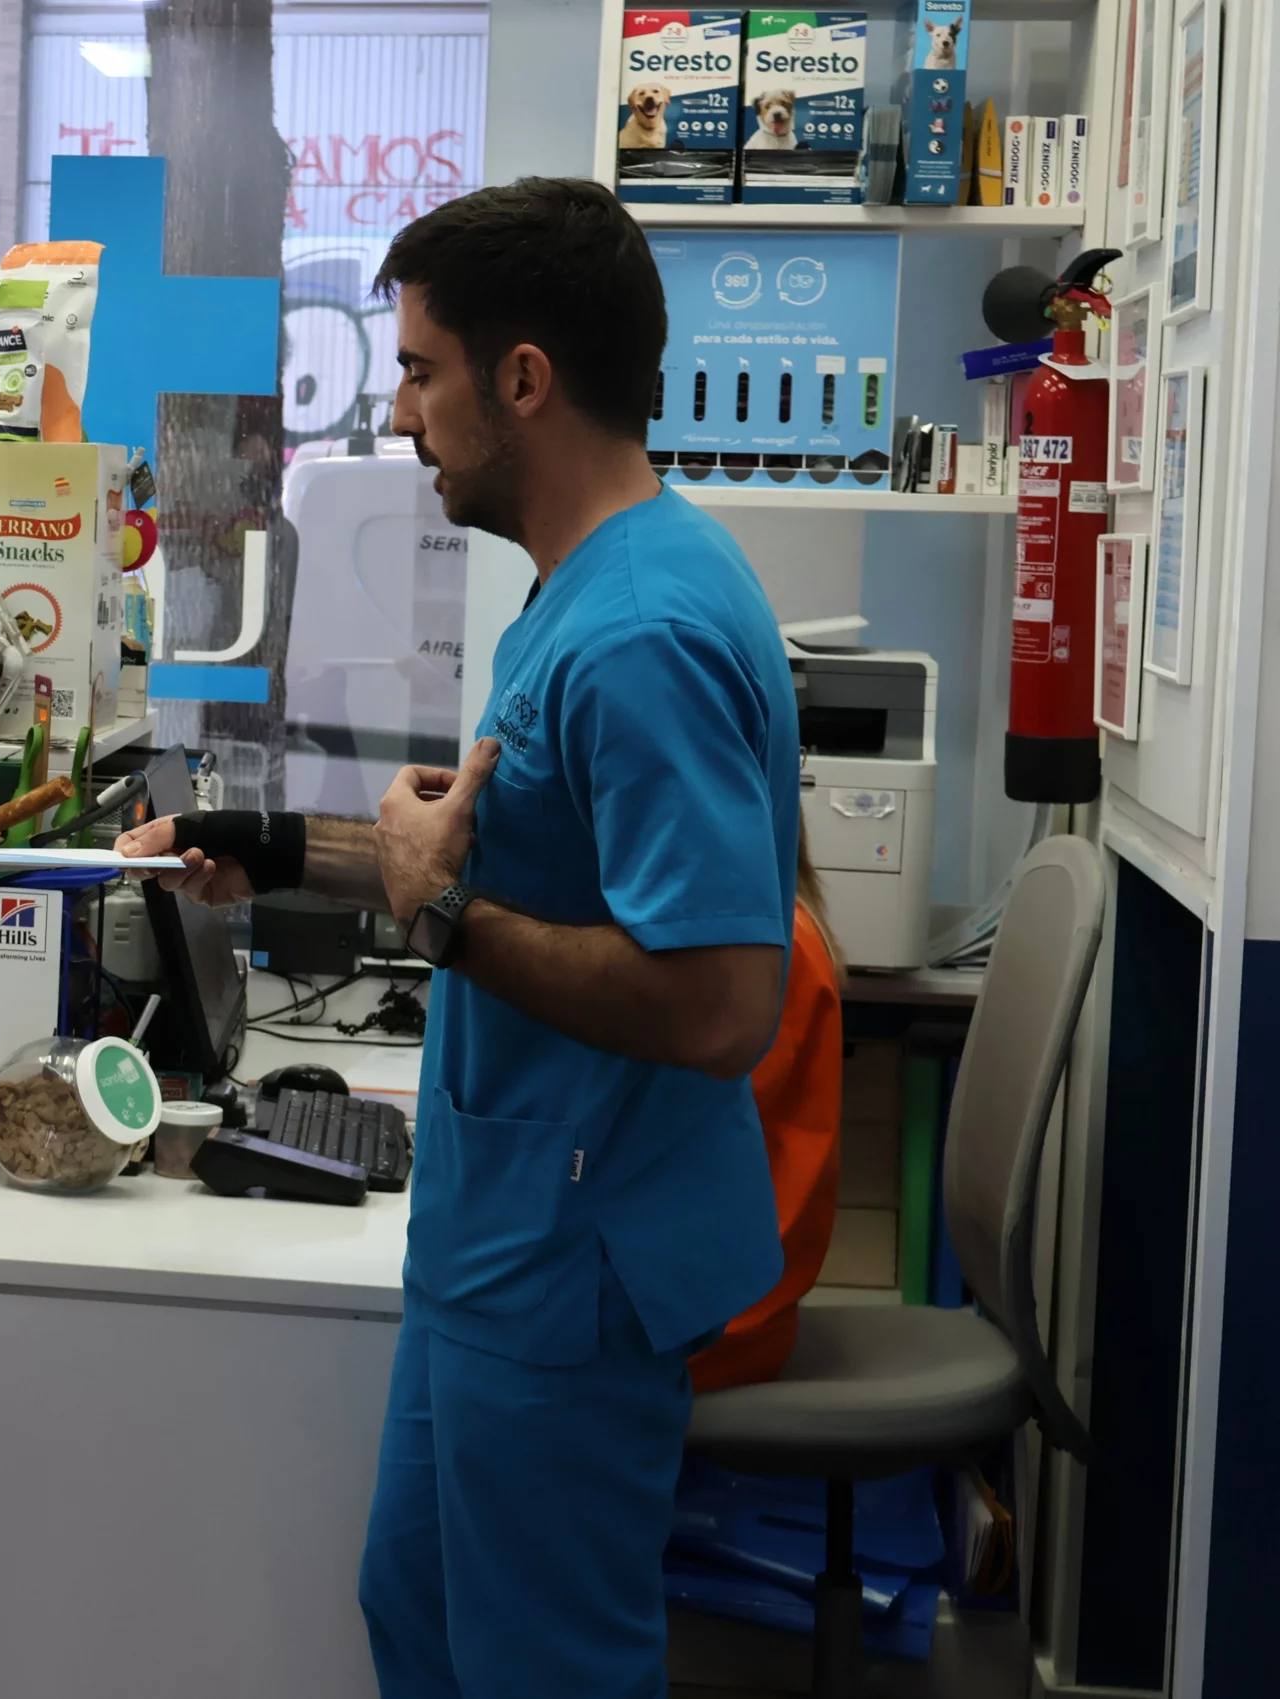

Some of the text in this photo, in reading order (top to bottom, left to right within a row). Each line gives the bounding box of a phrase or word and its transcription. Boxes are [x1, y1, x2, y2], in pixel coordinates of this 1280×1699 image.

[926, 2, 963, 11] Seresto
[629, 50, 732, 72] Seresto
[756, 51, 859, 74] Seresto
[708, 93, 729, 108] 12x
[834, 95, 856, 110] 12x
[693, 335, 722, 345] para
[724, 334, 753, 344] cada
[755, 333, 788, 344] estilo
[792, 334, 808, 344] de
[1043, 439, 1069, 460] 472
